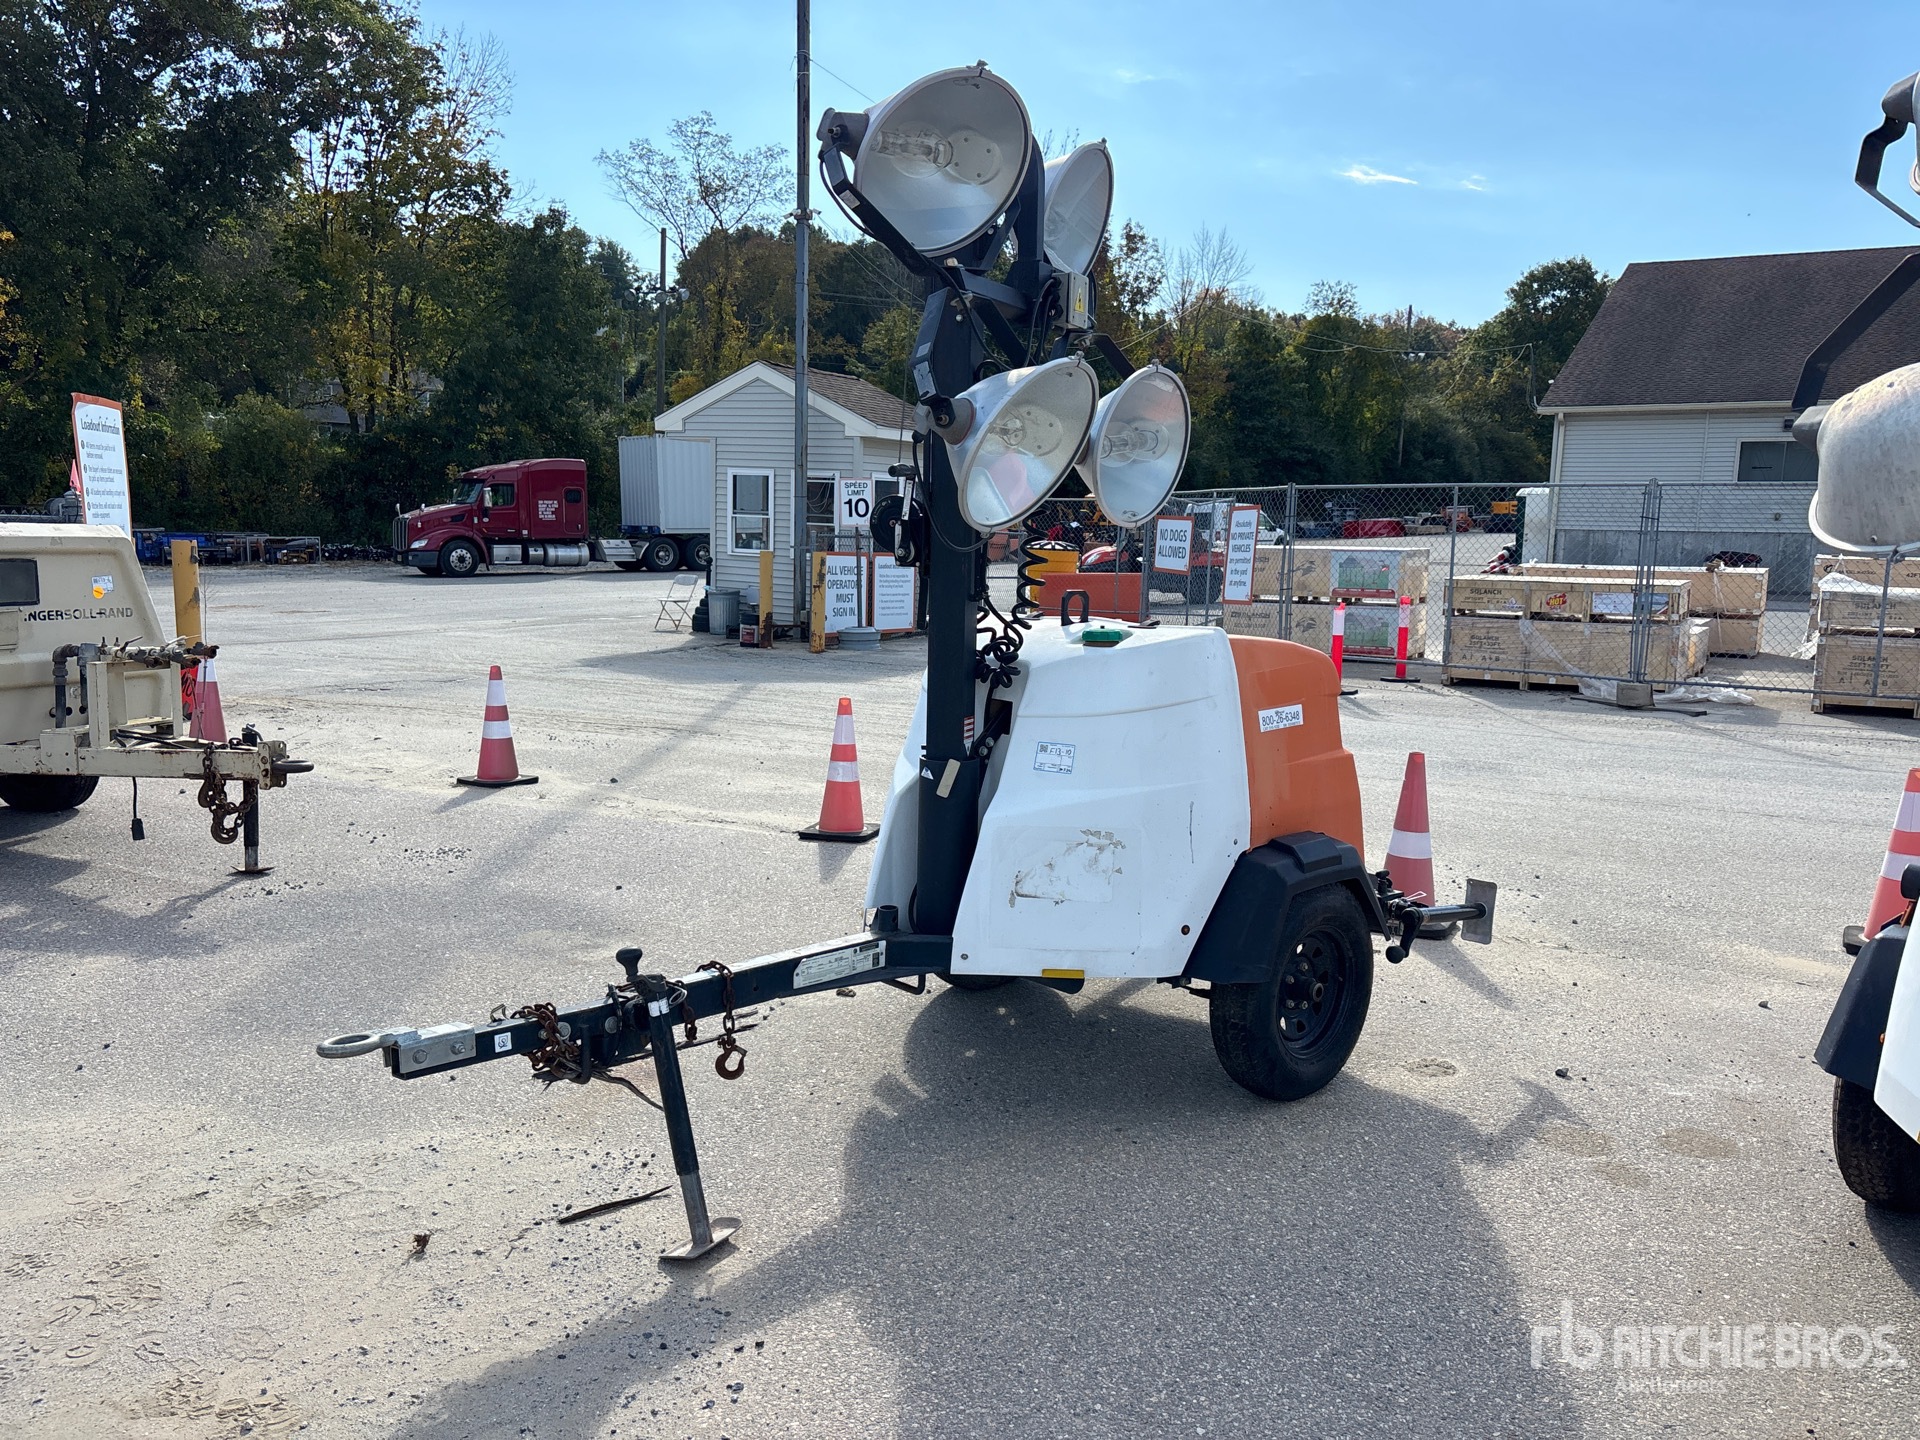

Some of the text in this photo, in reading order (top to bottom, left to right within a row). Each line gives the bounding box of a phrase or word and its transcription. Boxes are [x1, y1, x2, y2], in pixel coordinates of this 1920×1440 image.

[843, 498, 870, 518] 10
[1160, 529, 1187, 542] NO DOGS
[1238, 531, 1254, 540] PRIVATE
[1158, 545, 1187, 559] ALLOWED
[1231, 544, 1251, 553] VEHICLES
[827, 566, 864, 576] ALL VEHICE
[835, 594, 854, 603] MUST
[1549, 597, 1564, 605] HOT
[832, 607, 847, 617] SIGN
